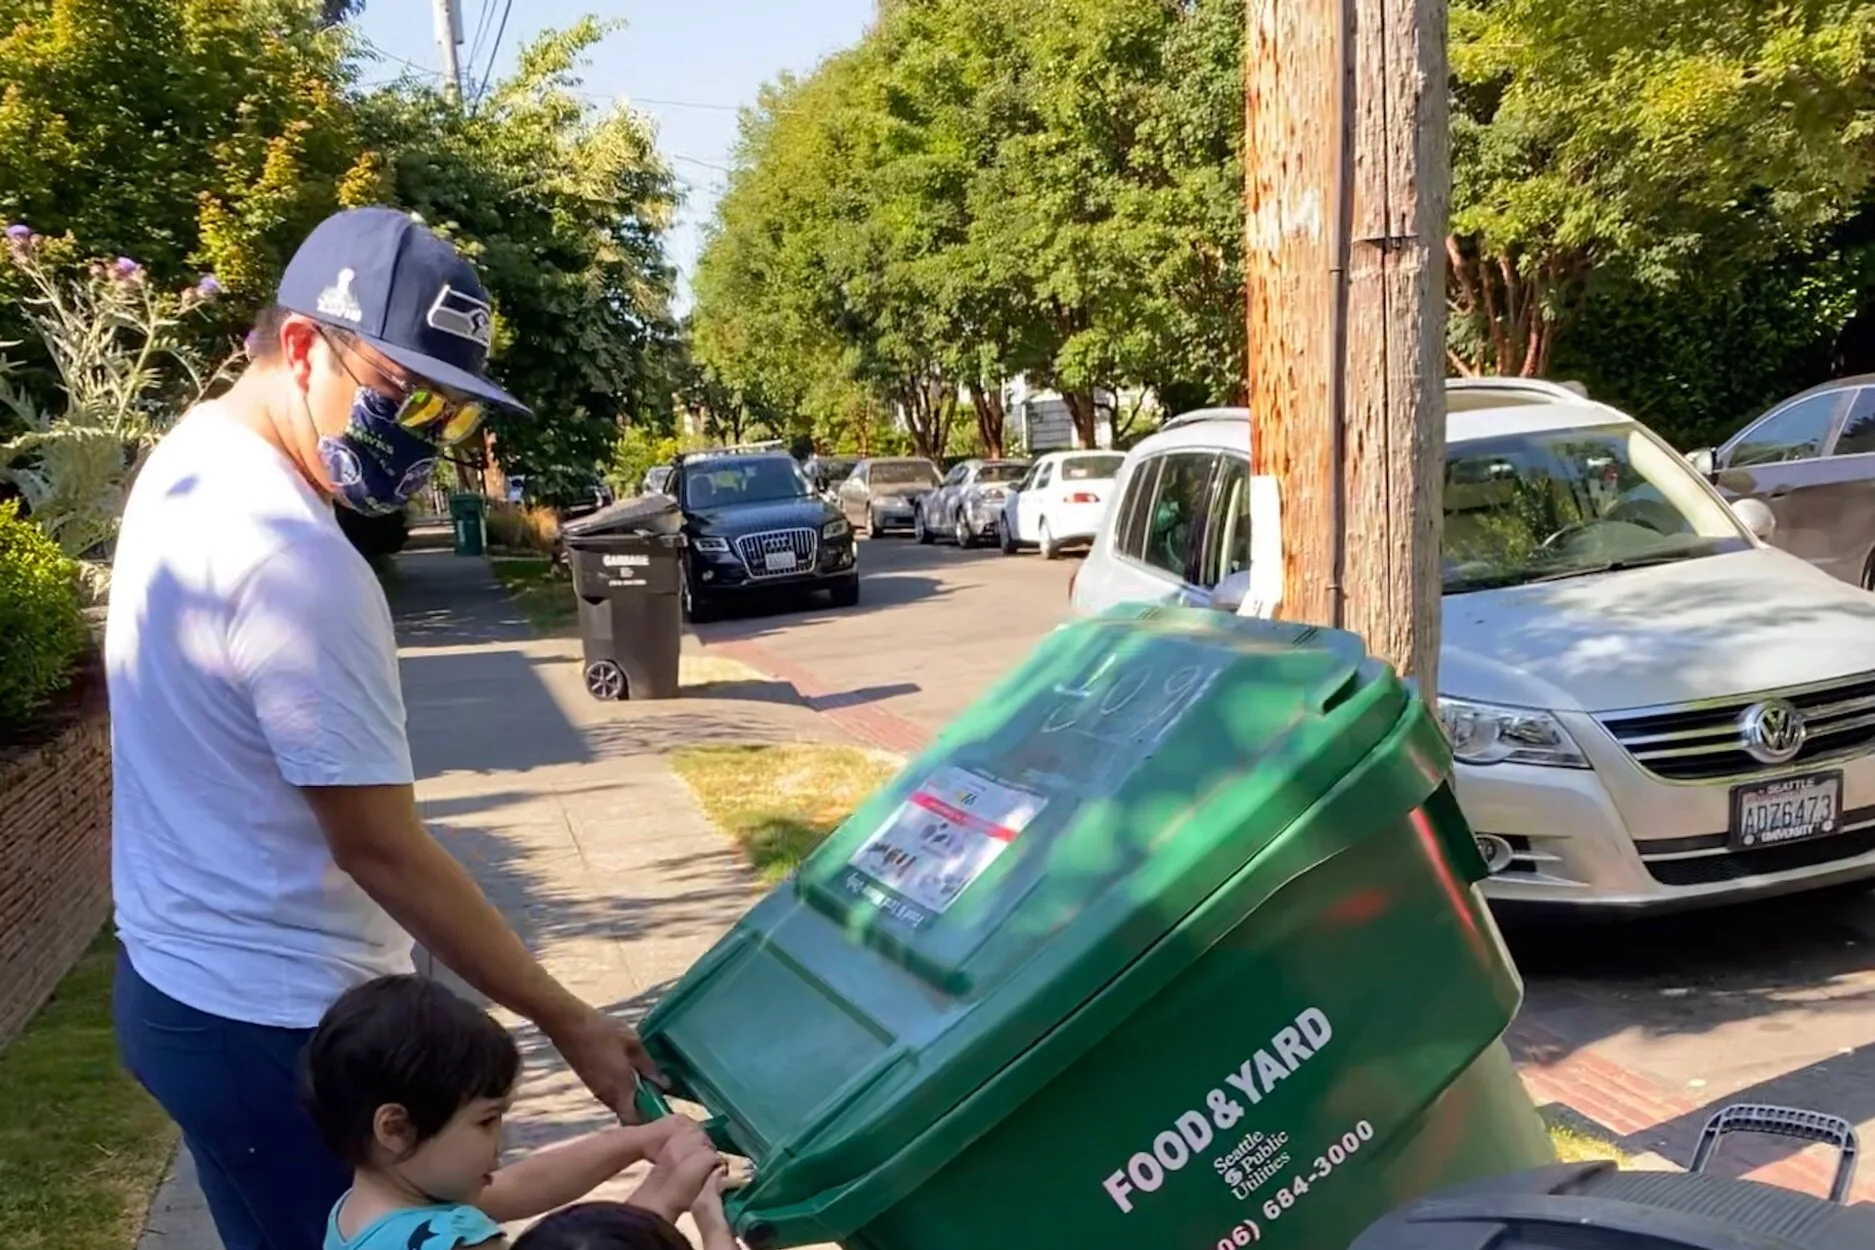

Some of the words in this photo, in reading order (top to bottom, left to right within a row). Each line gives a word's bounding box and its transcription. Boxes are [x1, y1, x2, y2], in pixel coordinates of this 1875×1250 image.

[1767, 777, 1815, 794] SEATTLE
[1213, 1131, 1265, 1175] Seattle
[1240, 1131, 1289, 1174] Public
[1262, 1120, 1374, 1220] 684-3000
[1231, 1151, 1291, 1200] Utilities
